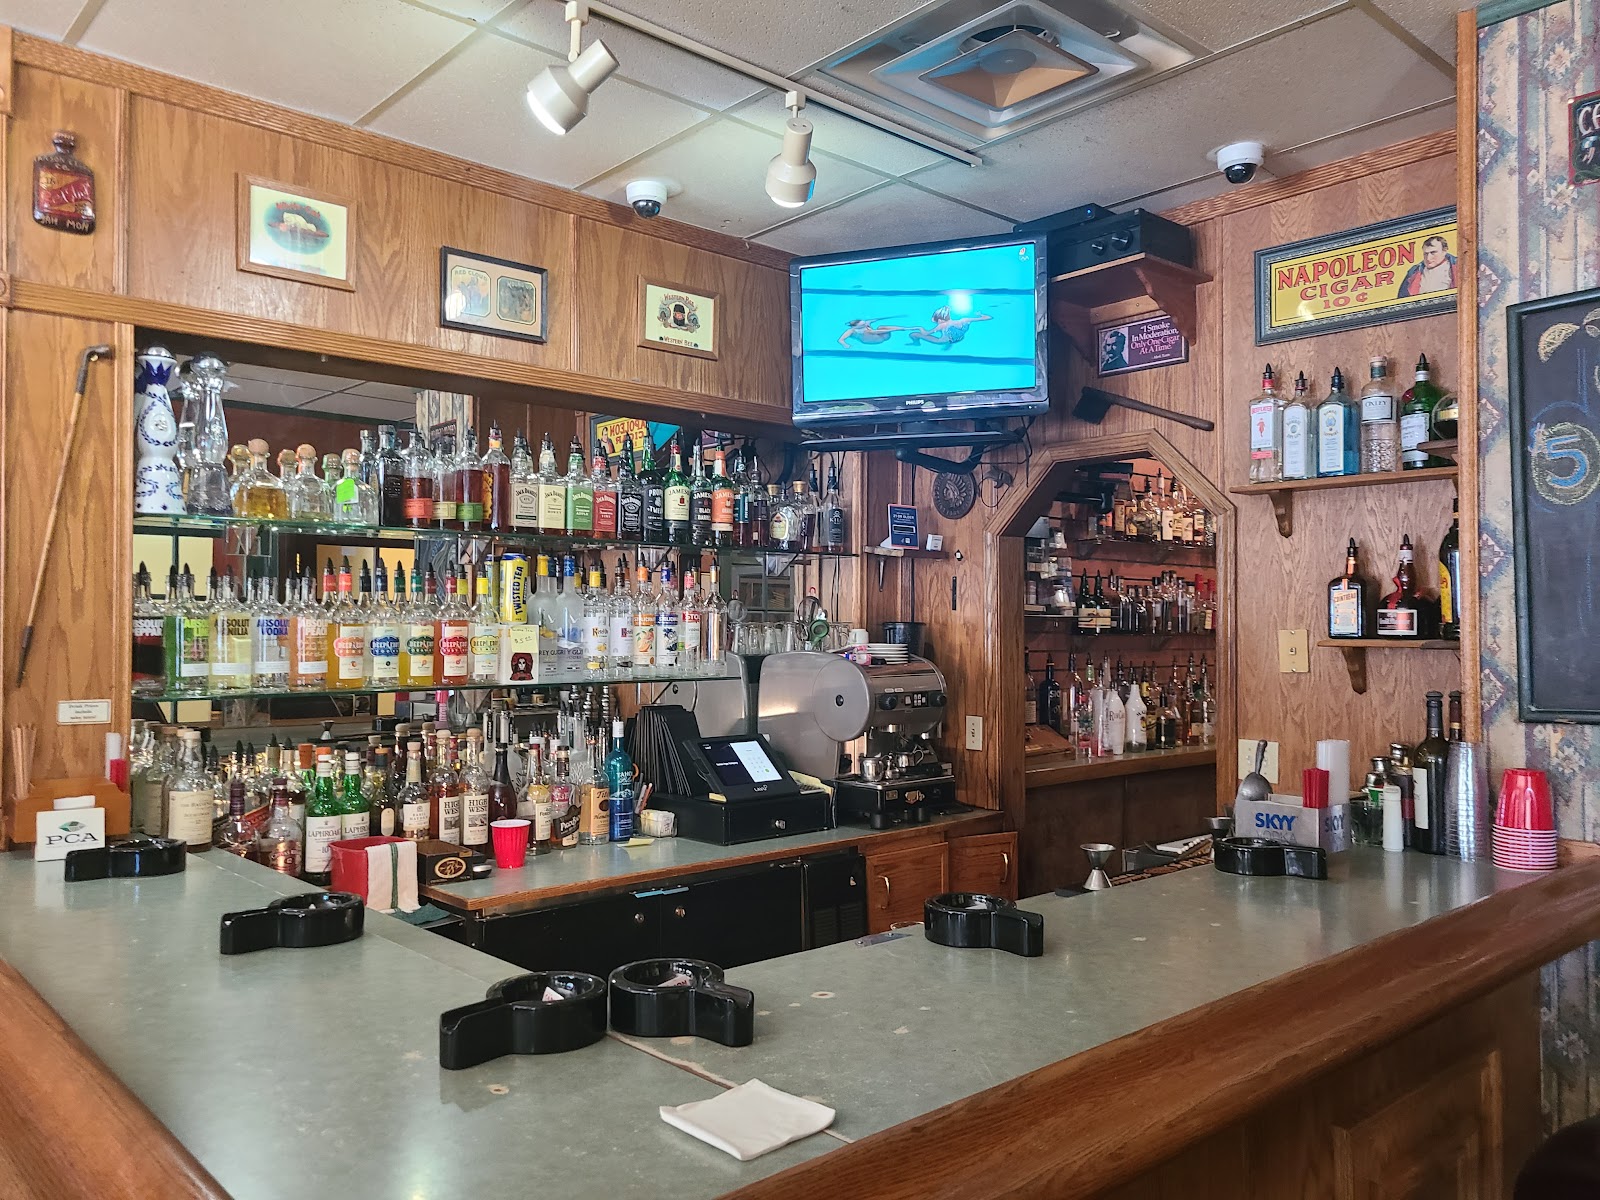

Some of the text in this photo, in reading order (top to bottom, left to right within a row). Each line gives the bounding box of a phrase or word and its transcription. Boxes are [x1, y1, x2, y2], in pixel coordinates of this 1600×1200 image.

[1278, 241, 1416, 291] NAPOLEON
[1299, 270, 1396, 301] CIGAR
[1147, 322, 1171, 331] Smoke
[1130, 334, 1181, 350] Only One Cigar
[1132, 334, 1139, 342] In
[1139, 347, 1149, 355] At
[1365, 400, 1388, 408] OXLEY
[1252, 406, 1273, 414] BEEFEATER
[512, 566, 524, 615] TWISTED TEA
[685, 611, 699, 620] STO
[257, 618, 290, 628] ABSOLUT
[261, 627, 289, 636] VODKA
[473, 640, 486, 648] DEEP
[468, 799, 488, 807] HIGH
[444, 808, 460, 816] WES
[469, 806, 488, 814] WEST
[1255, 812, 1297, 831] SKYY
[344, 824, 370, 834] LAPHRO
[45, 832, 99, 845] PCA
